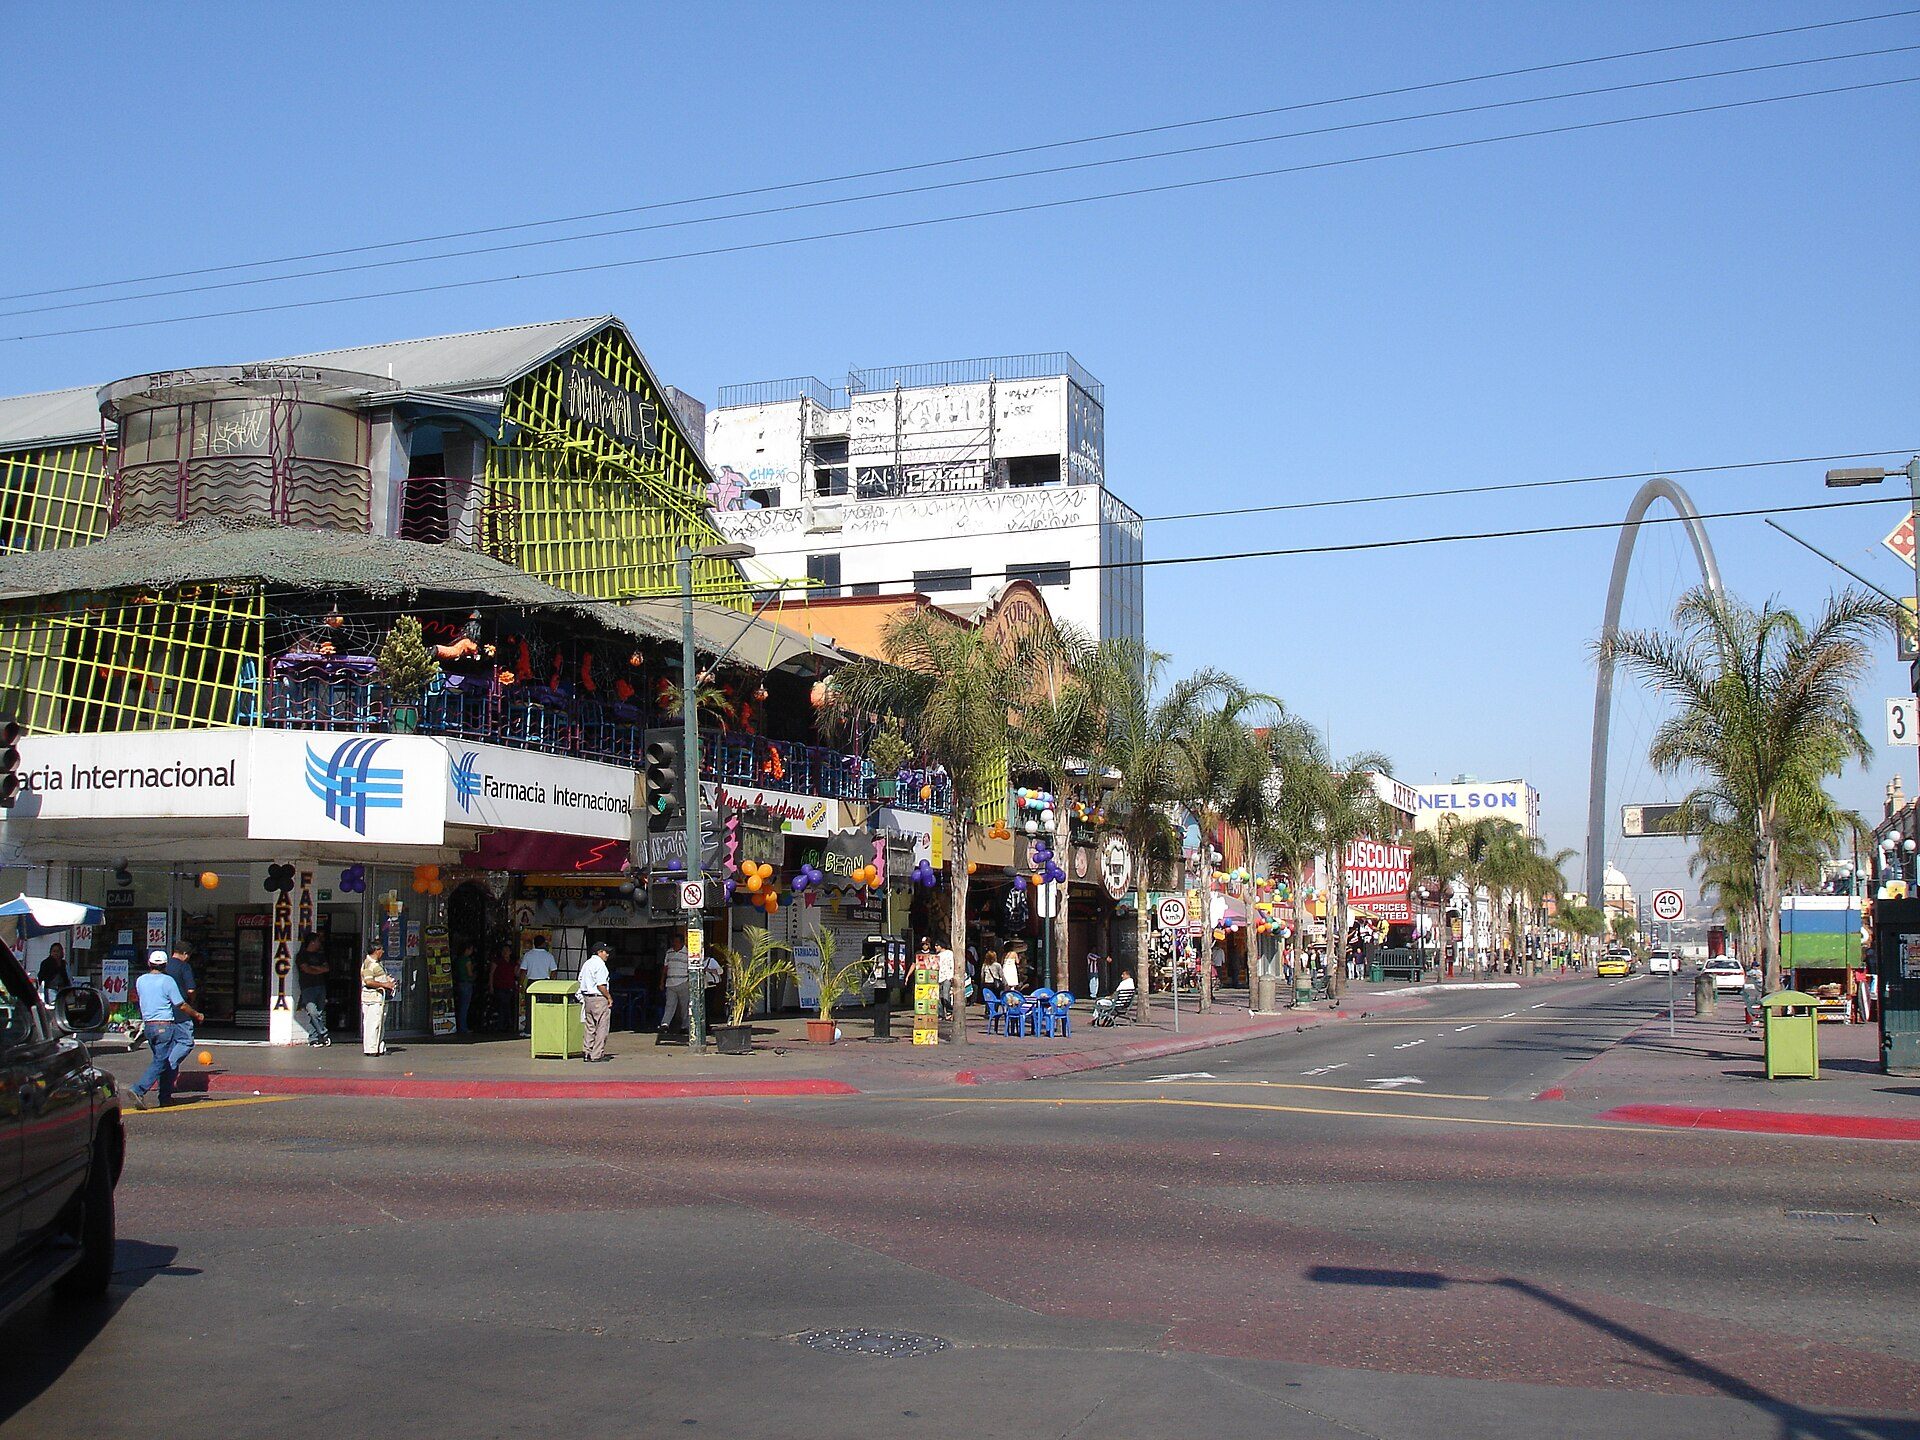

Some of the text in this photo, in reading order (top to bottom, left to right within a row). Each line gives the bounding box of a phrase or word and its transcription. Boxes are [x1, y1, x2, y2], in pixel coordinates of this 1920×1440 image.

[1892, 705, 1906, 739] 3
[17, 759, 235, 791] acia Internacional
[484, 774, 632, 817] Farmacia Internacional
[1392, 782, 1417, 813] AZTEC
[1418, 793, 1517, 809] NELSON
[807, 801, 823, 820] TACO
[811, 811, 827, 831] SHOP
[1345, 841, 1412, 870] DISCOUNT
[1346, 870, 1412, 898] PHARMACY
[1165, 903, 1179, 912] 40
[1372, 903, 1407, 912] PRICES
[1659, 896, 1676, 905] 40
[273, 890, 293, 1011] ARMACIA
